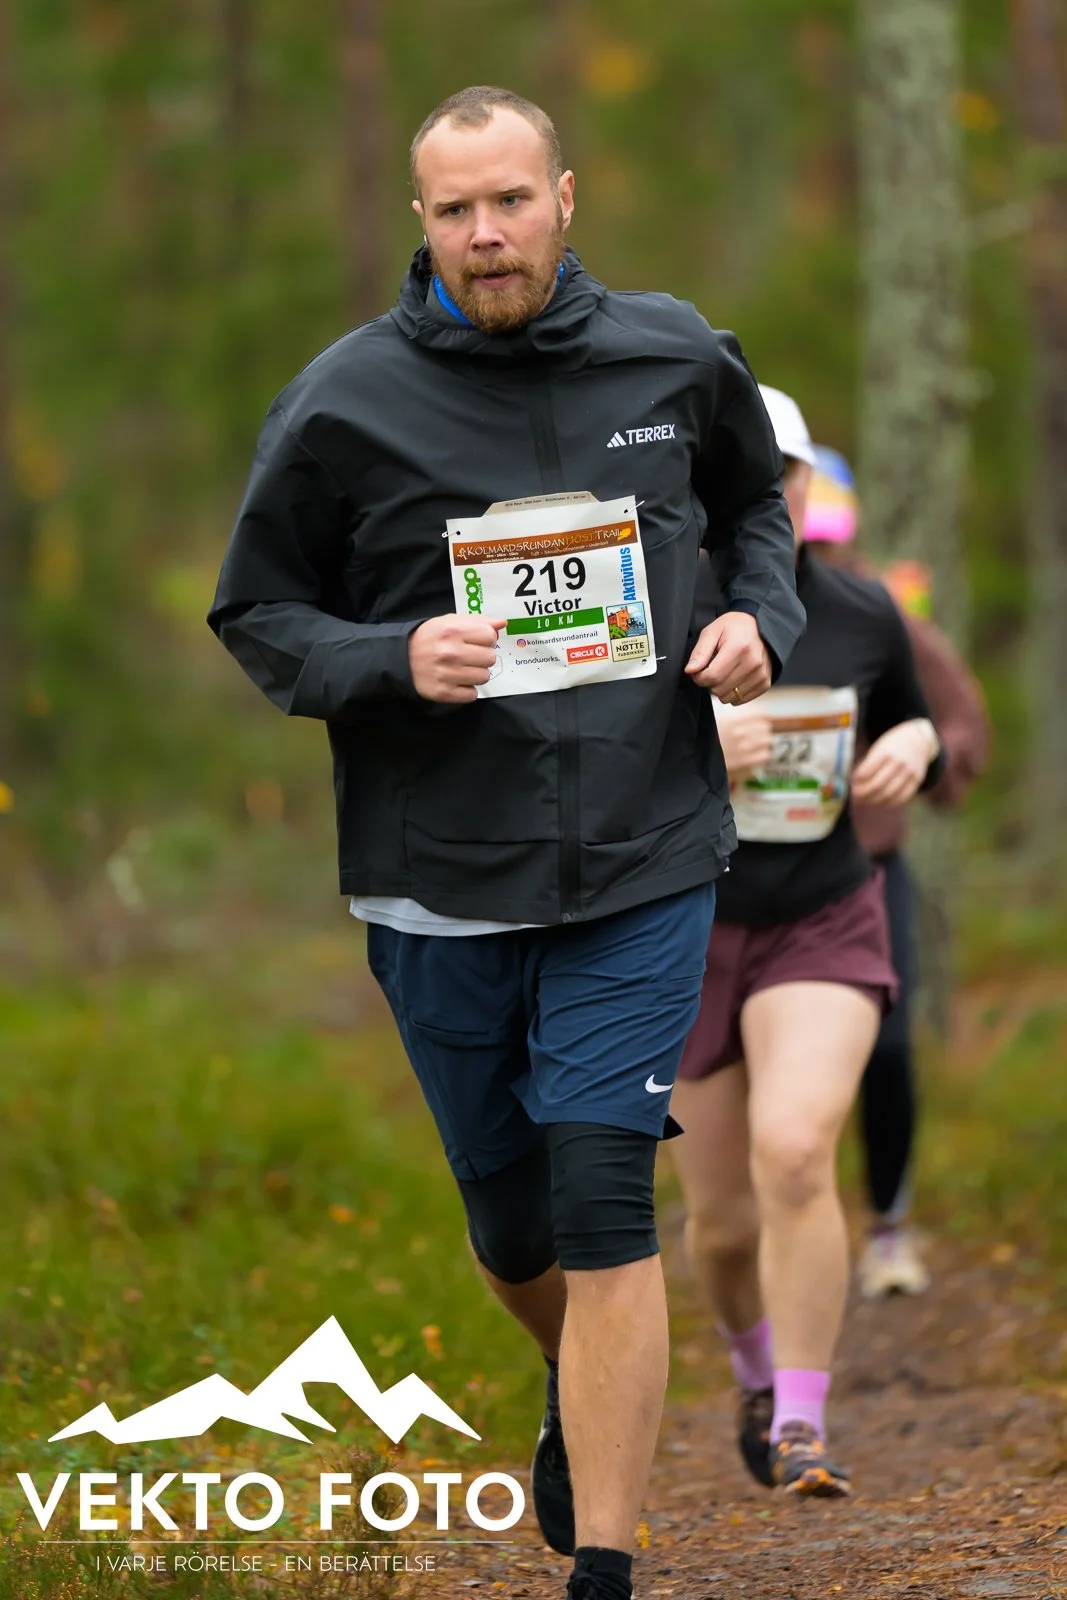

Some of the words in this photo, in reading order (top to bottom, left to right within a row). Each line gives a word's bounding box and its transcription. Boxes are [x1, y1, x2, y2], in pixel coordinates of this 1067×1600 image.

[626, 424, 675, 445] TERREX
[512, 557, 586, 597] 219
[620, 547, 637, 601] Aktivitus
[524, 598, 582, 616] Victor
[537, 618, 550, 629] 10
[558, 615, 574, 625] KM
[526, 631, 598, 646] kolmardsrundantrail
[570, 649, 595, 659] CIRCLE
[615, 641, 645, 653] NØTTE
